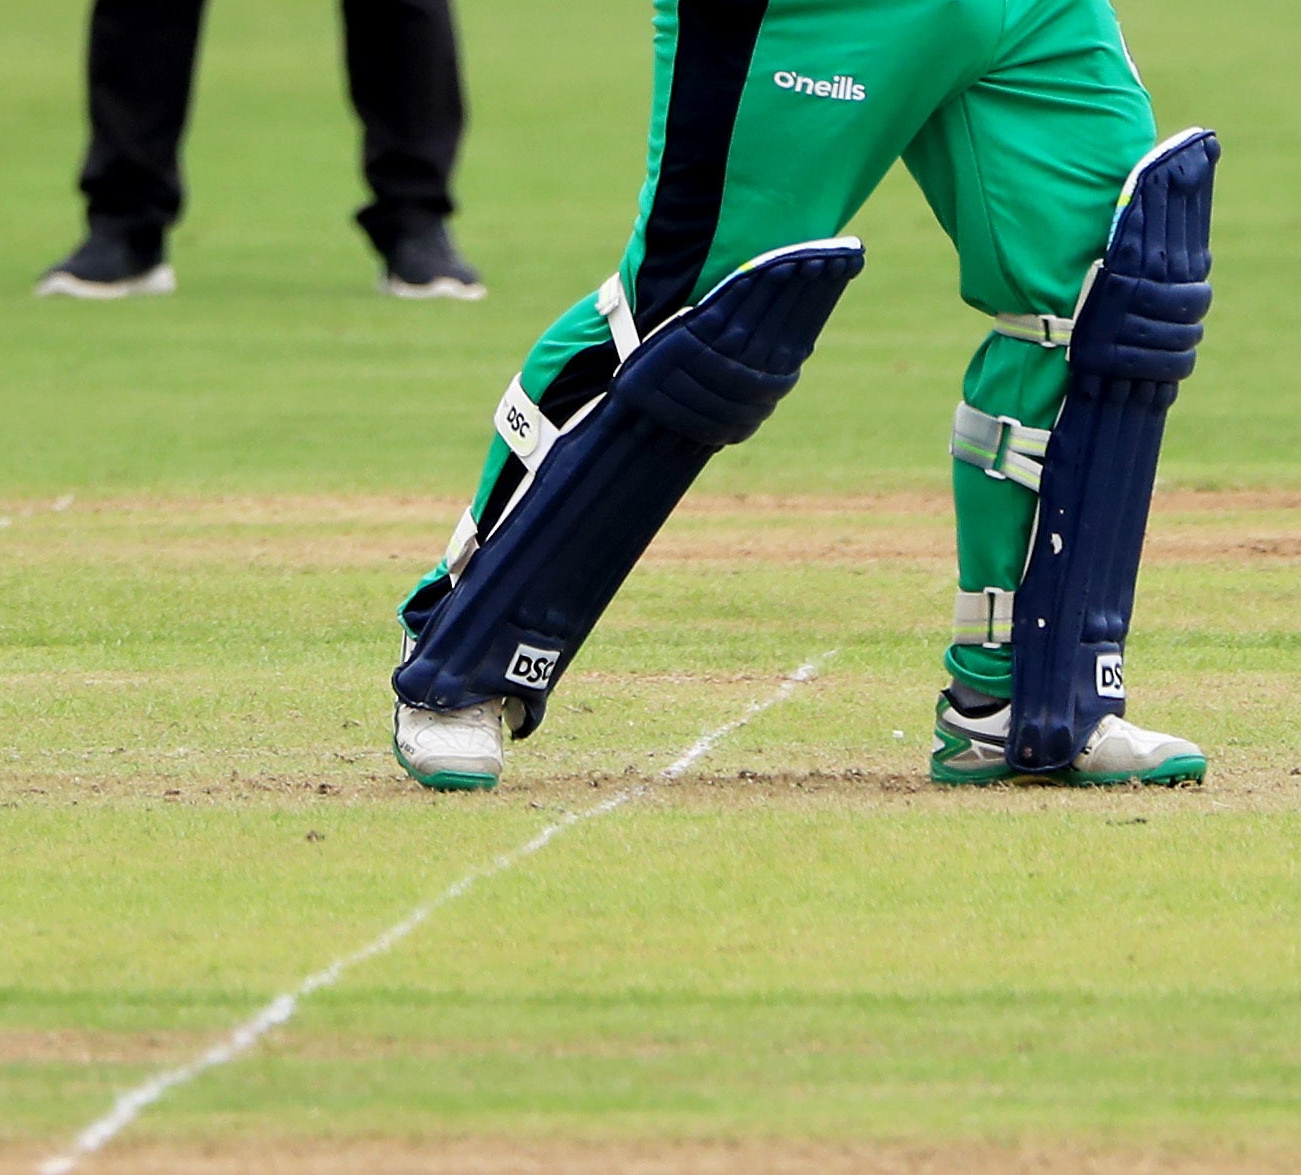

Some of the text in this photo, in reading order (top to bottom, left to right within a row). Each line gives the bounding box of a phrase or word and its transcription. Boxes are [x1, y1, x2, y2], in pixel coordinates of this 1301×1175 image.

[773, 70, 867, 101] o'neills
[506, 405, 531, 439] DSC
[1101, 662, 1124, 691] DS
